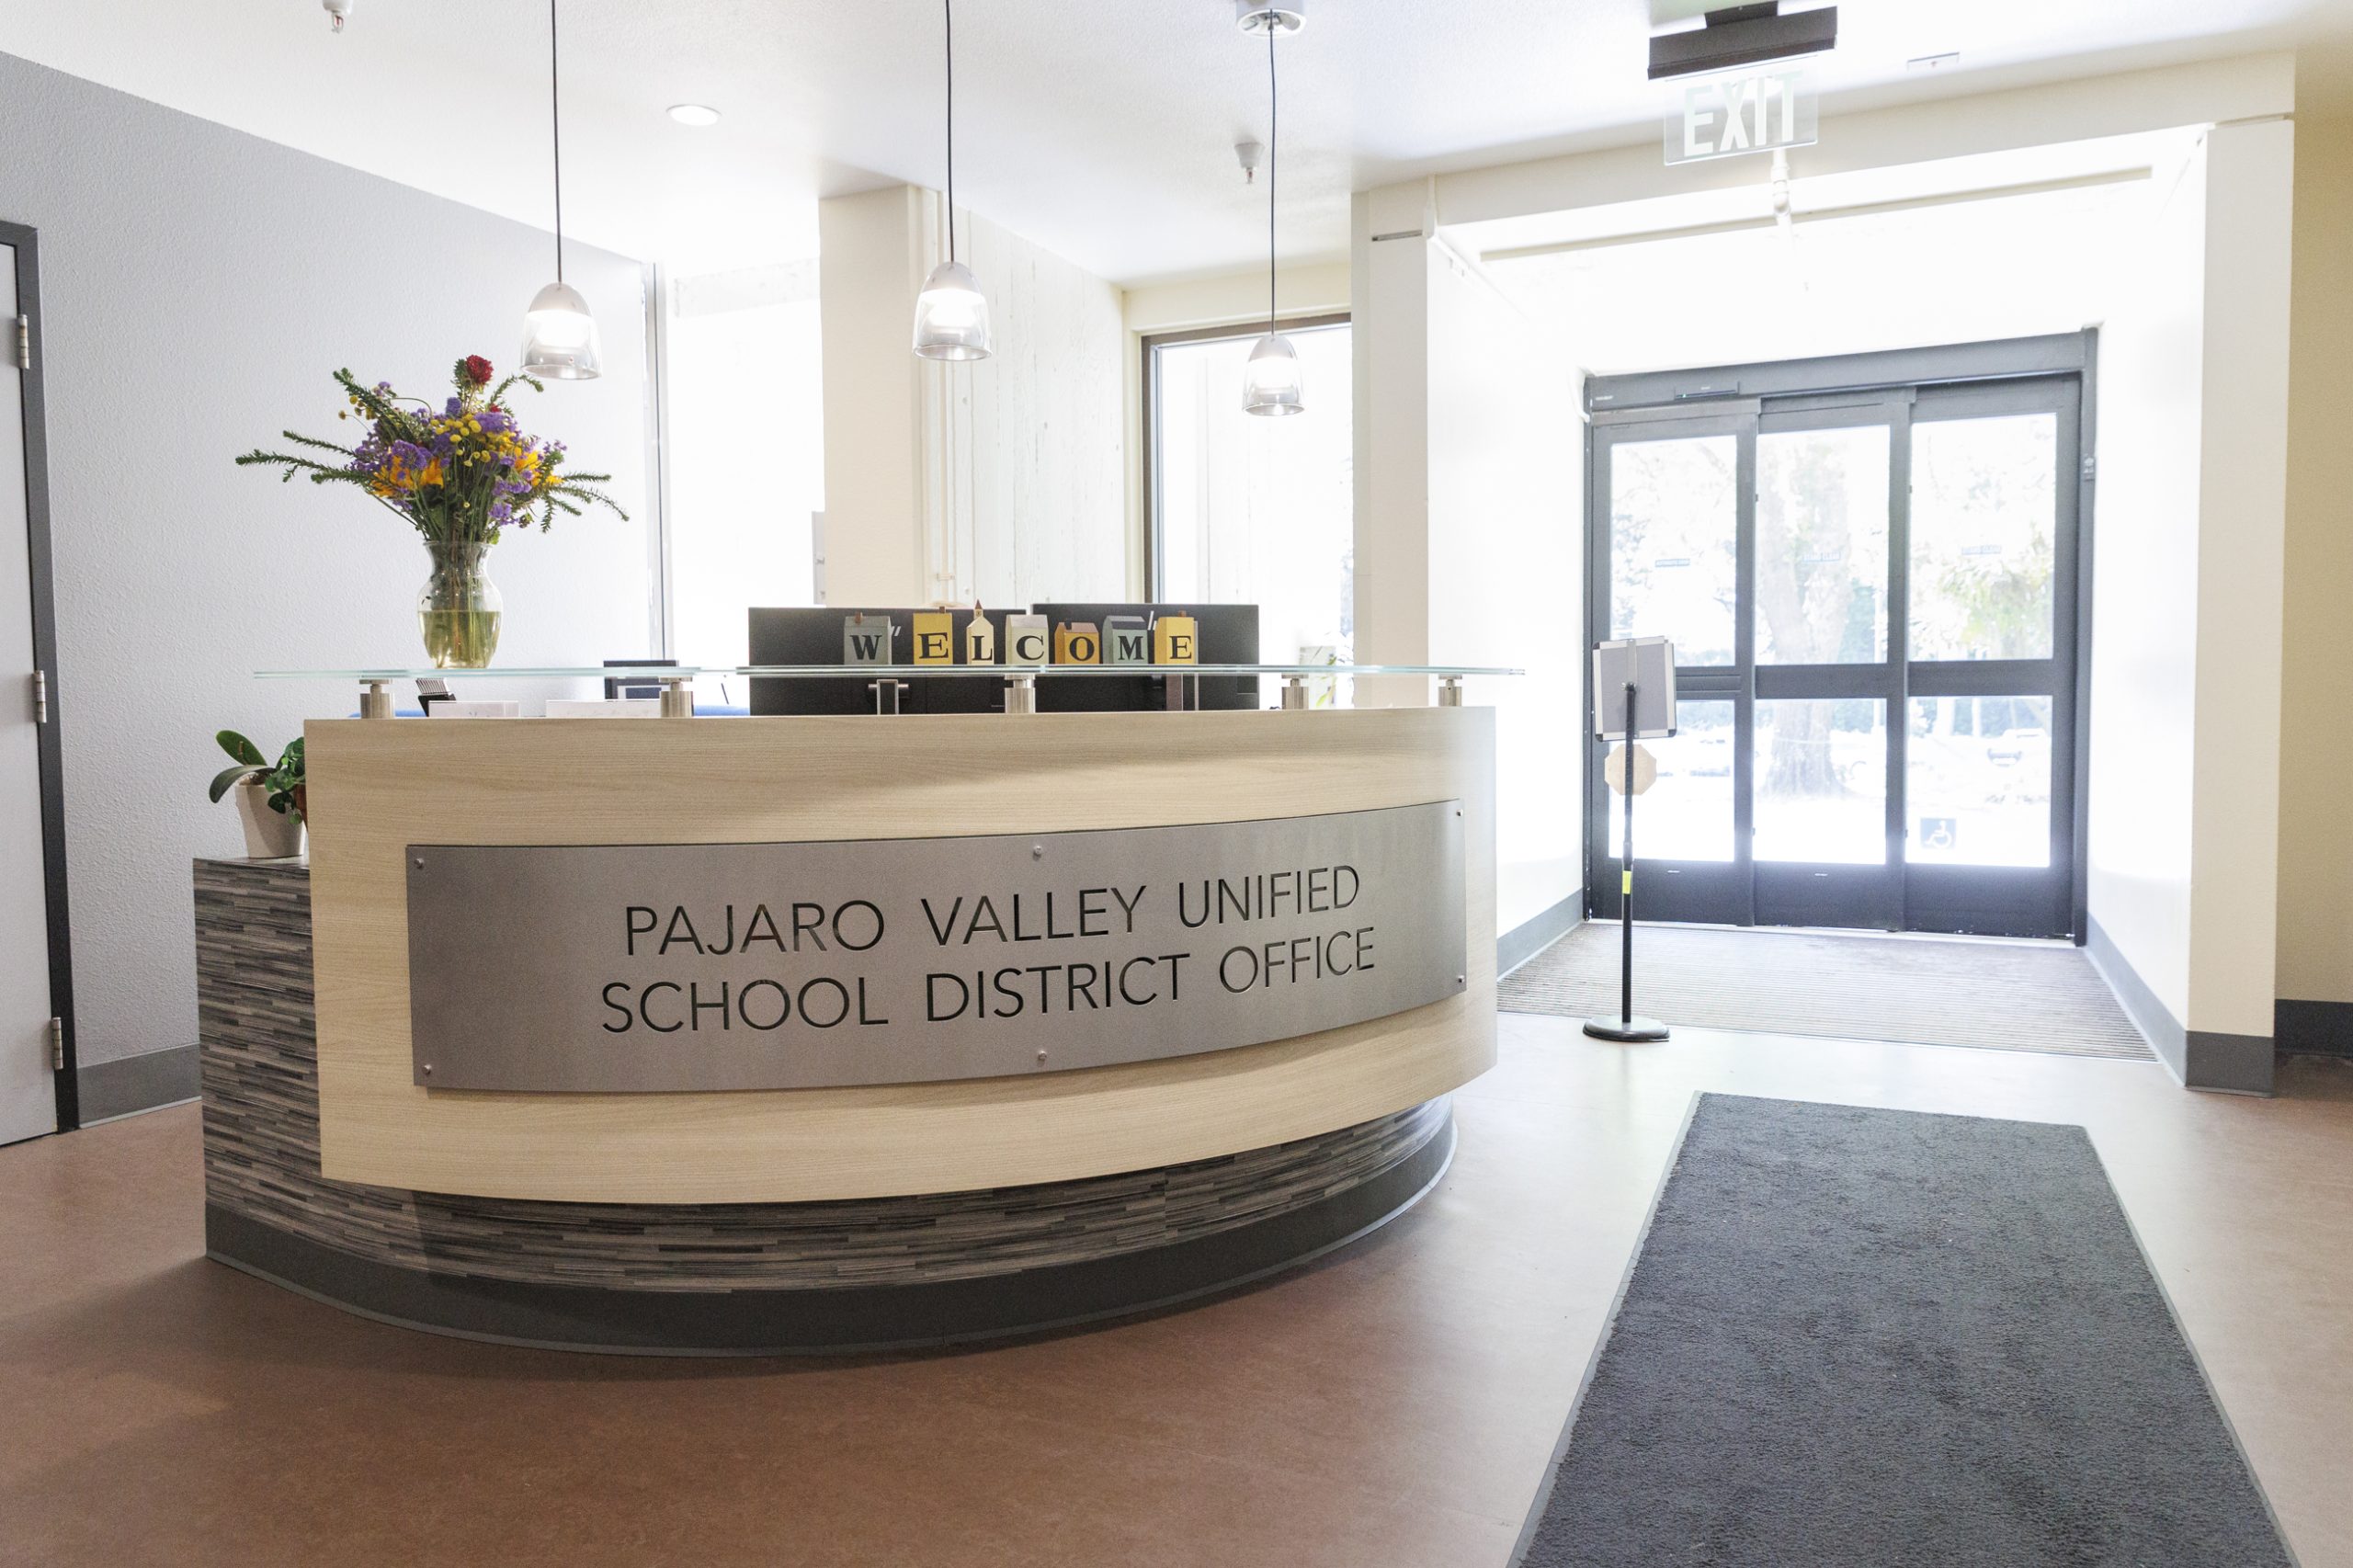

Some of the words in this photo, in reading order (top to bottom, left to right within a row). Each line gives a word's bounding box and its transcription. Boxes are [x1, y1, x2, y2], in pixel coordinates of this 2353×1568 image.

[1684, 70, 1803, 157] EXIT
[849, 631, 1193, 661] WELCOME
[625, 900, 885, 956] PAJARO
[920, 885, 1147, 947] VALLEY
[1178, 865, 1360, 929] UNIFIED
[601, 977, 890, 1033] SCHOOL
[926, 953, 1191, 1022] DISTRICT
[1219, 926, 1375, 994] OFFICE
